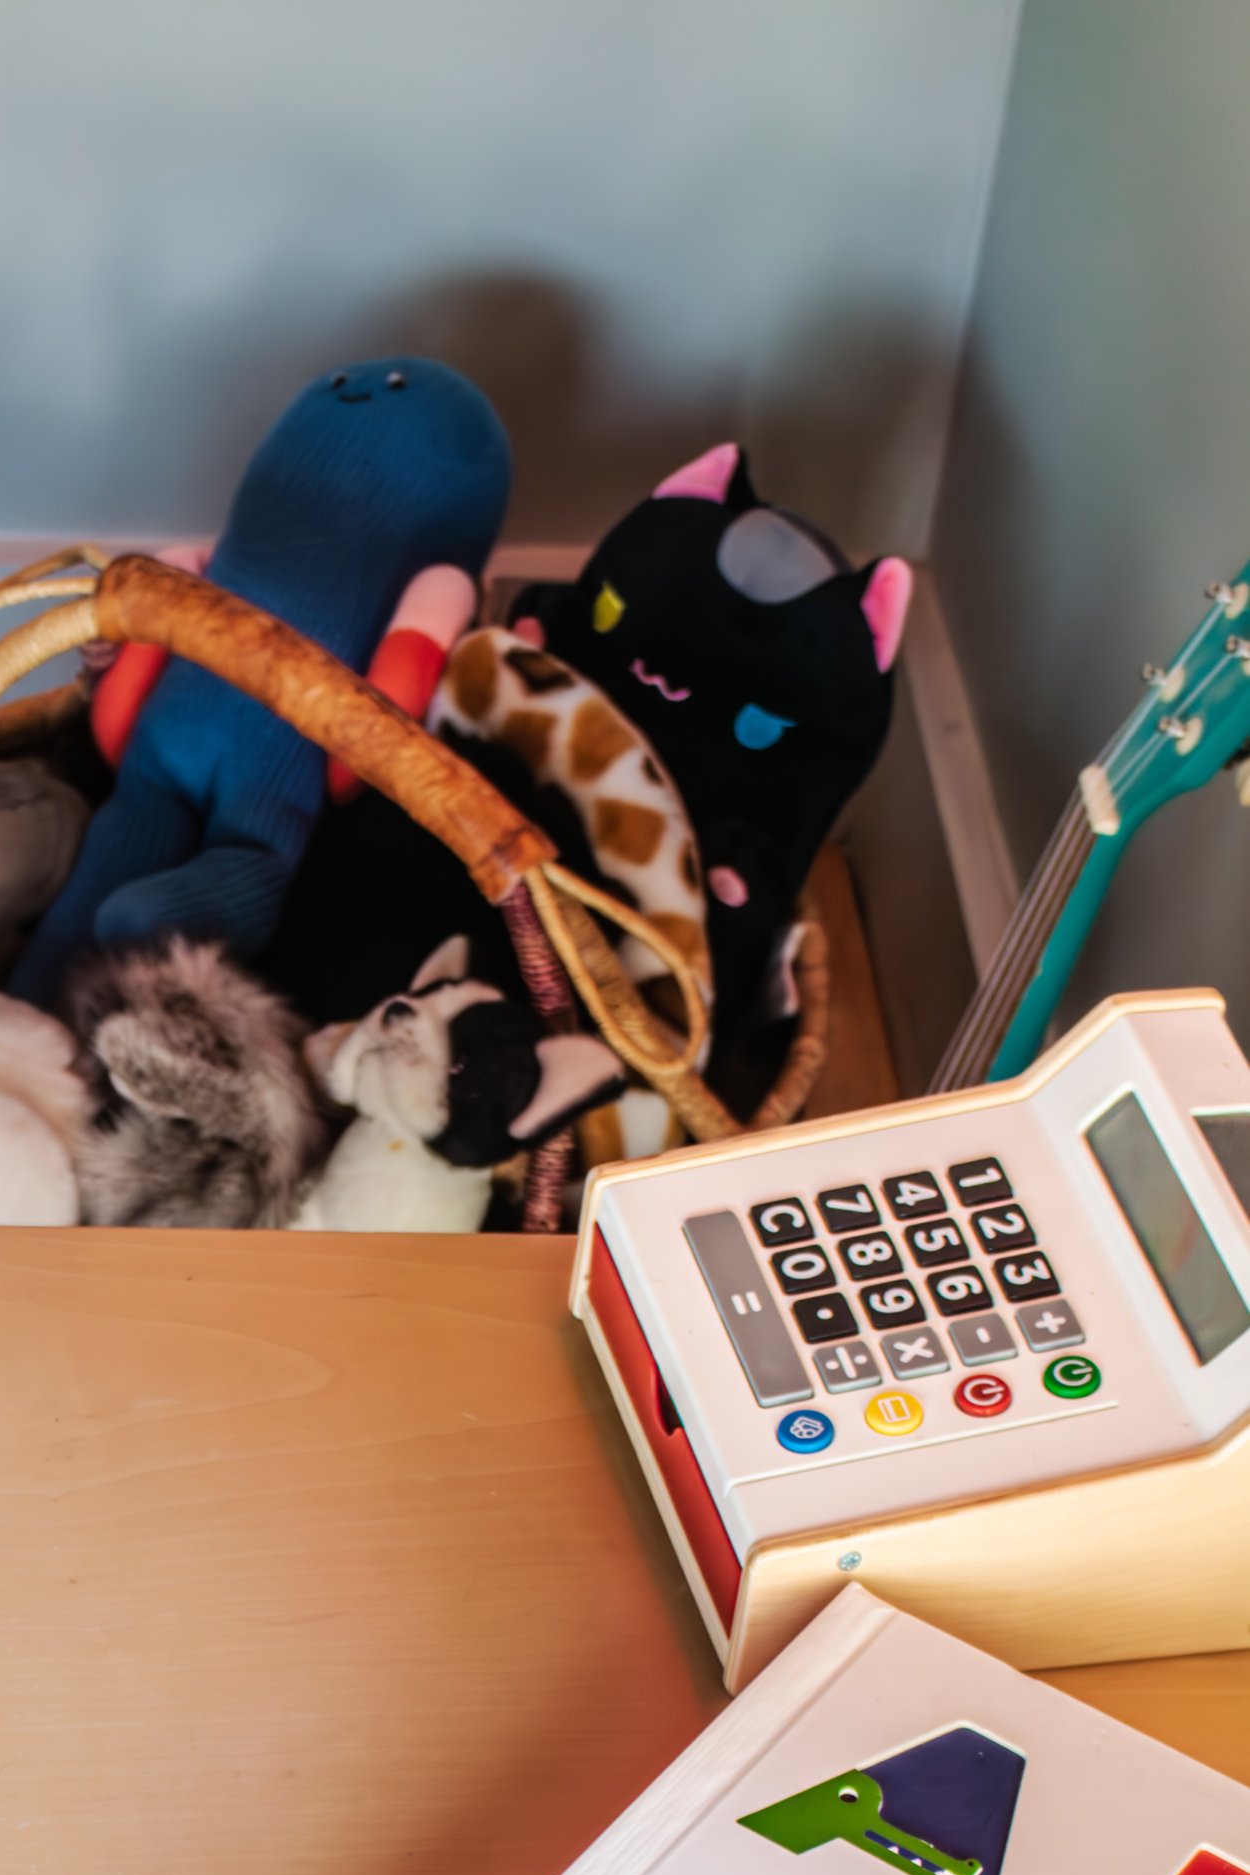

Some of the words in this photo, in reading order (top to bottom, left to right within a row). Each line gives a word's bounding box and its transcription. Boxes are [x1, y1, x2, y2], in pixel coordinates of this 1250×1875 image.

[959, 1167, 1002, 1188] 1
[825, 1191, 873, 1214] 7
[895, 1181, 938, 1206] 4
[760, 1204, 806, 1233] C
[978, 1212, 1025, 1239] 2
[914, 1227, 960, 1252] 5
[848, 1240, 893, 1266] 8
[1003, 1258, 1051, 1285] 3
[869, 1287, 915, 1313] 9
[937, 1274, 983, 1300] 6
